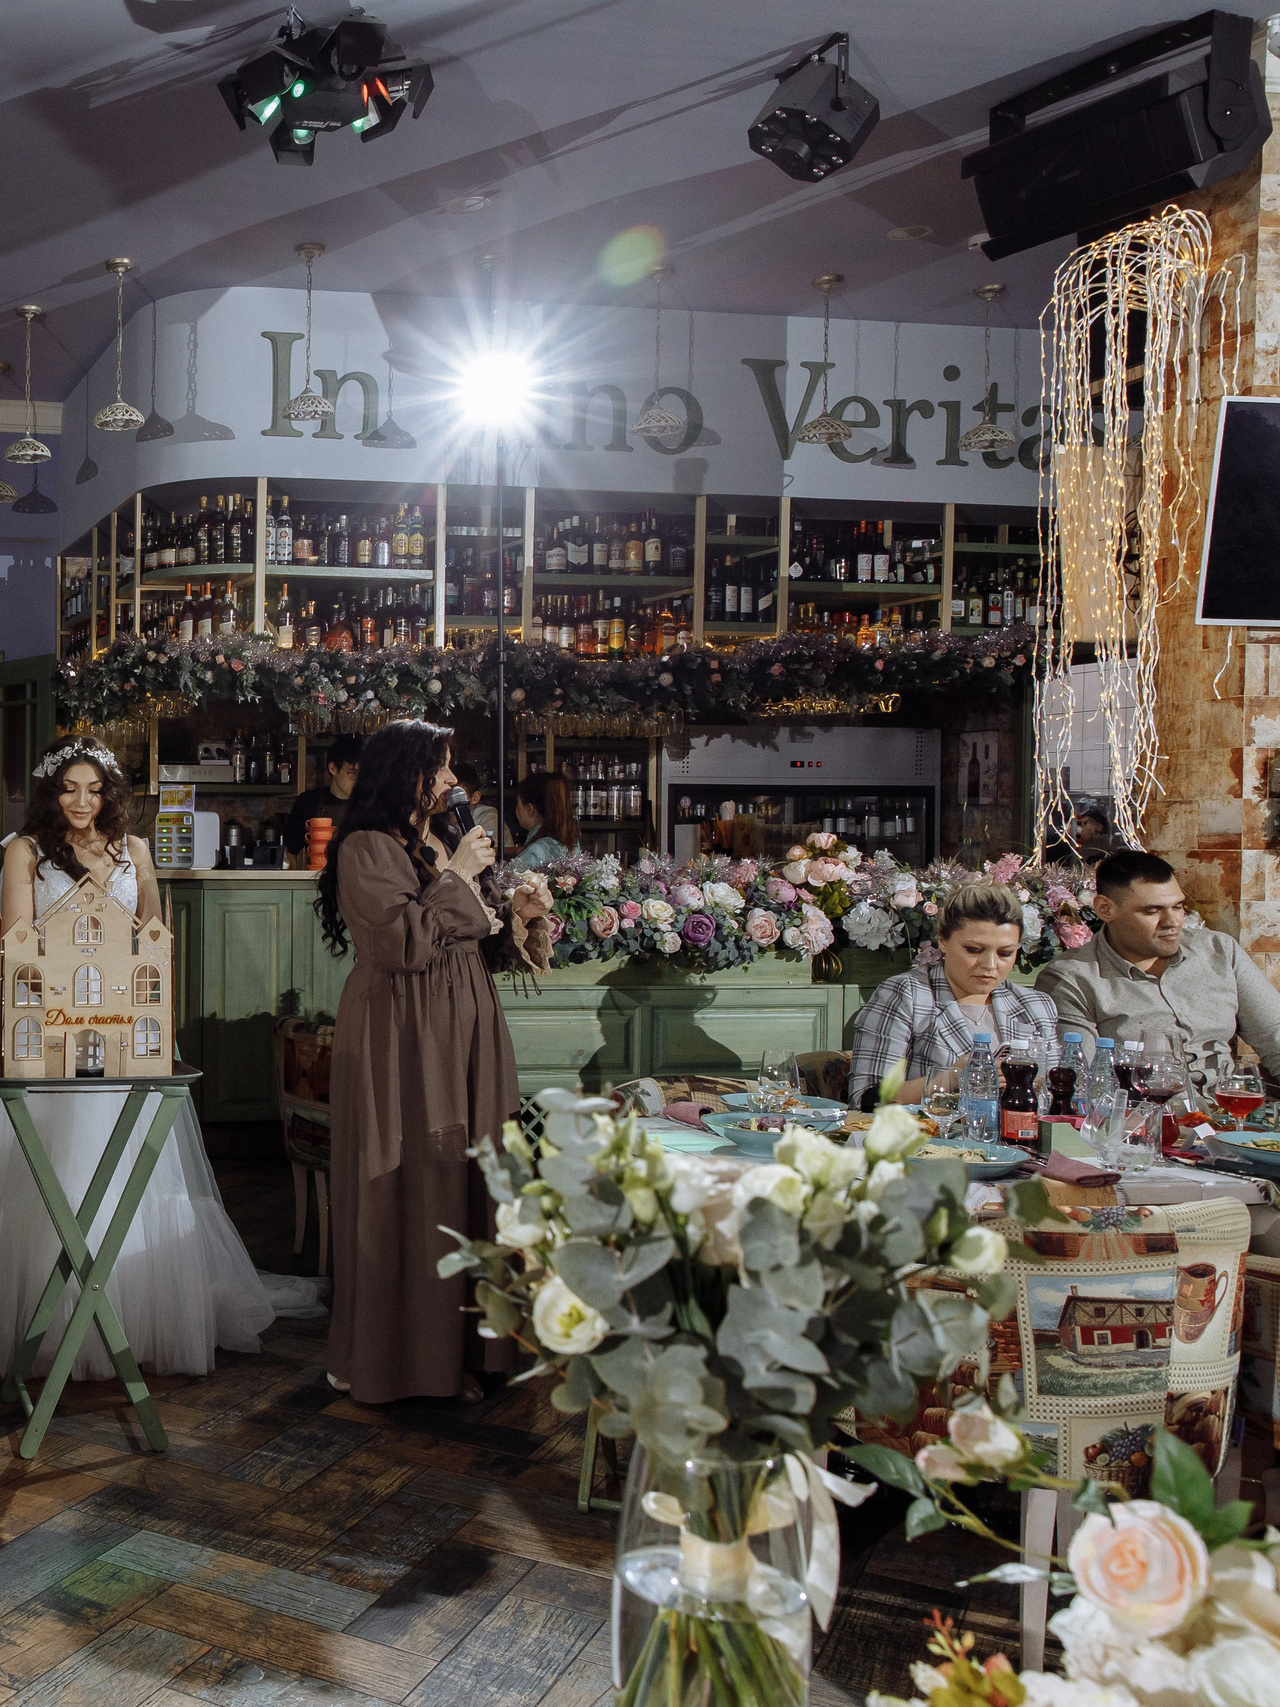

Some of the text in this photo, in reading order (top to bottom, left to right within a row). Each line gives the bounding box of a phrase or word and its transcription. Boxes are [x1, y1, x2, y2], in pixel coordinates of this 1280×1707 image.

[260, 330, 384, 441] In
[45, 1008, 134, 1027] Дом счастья
